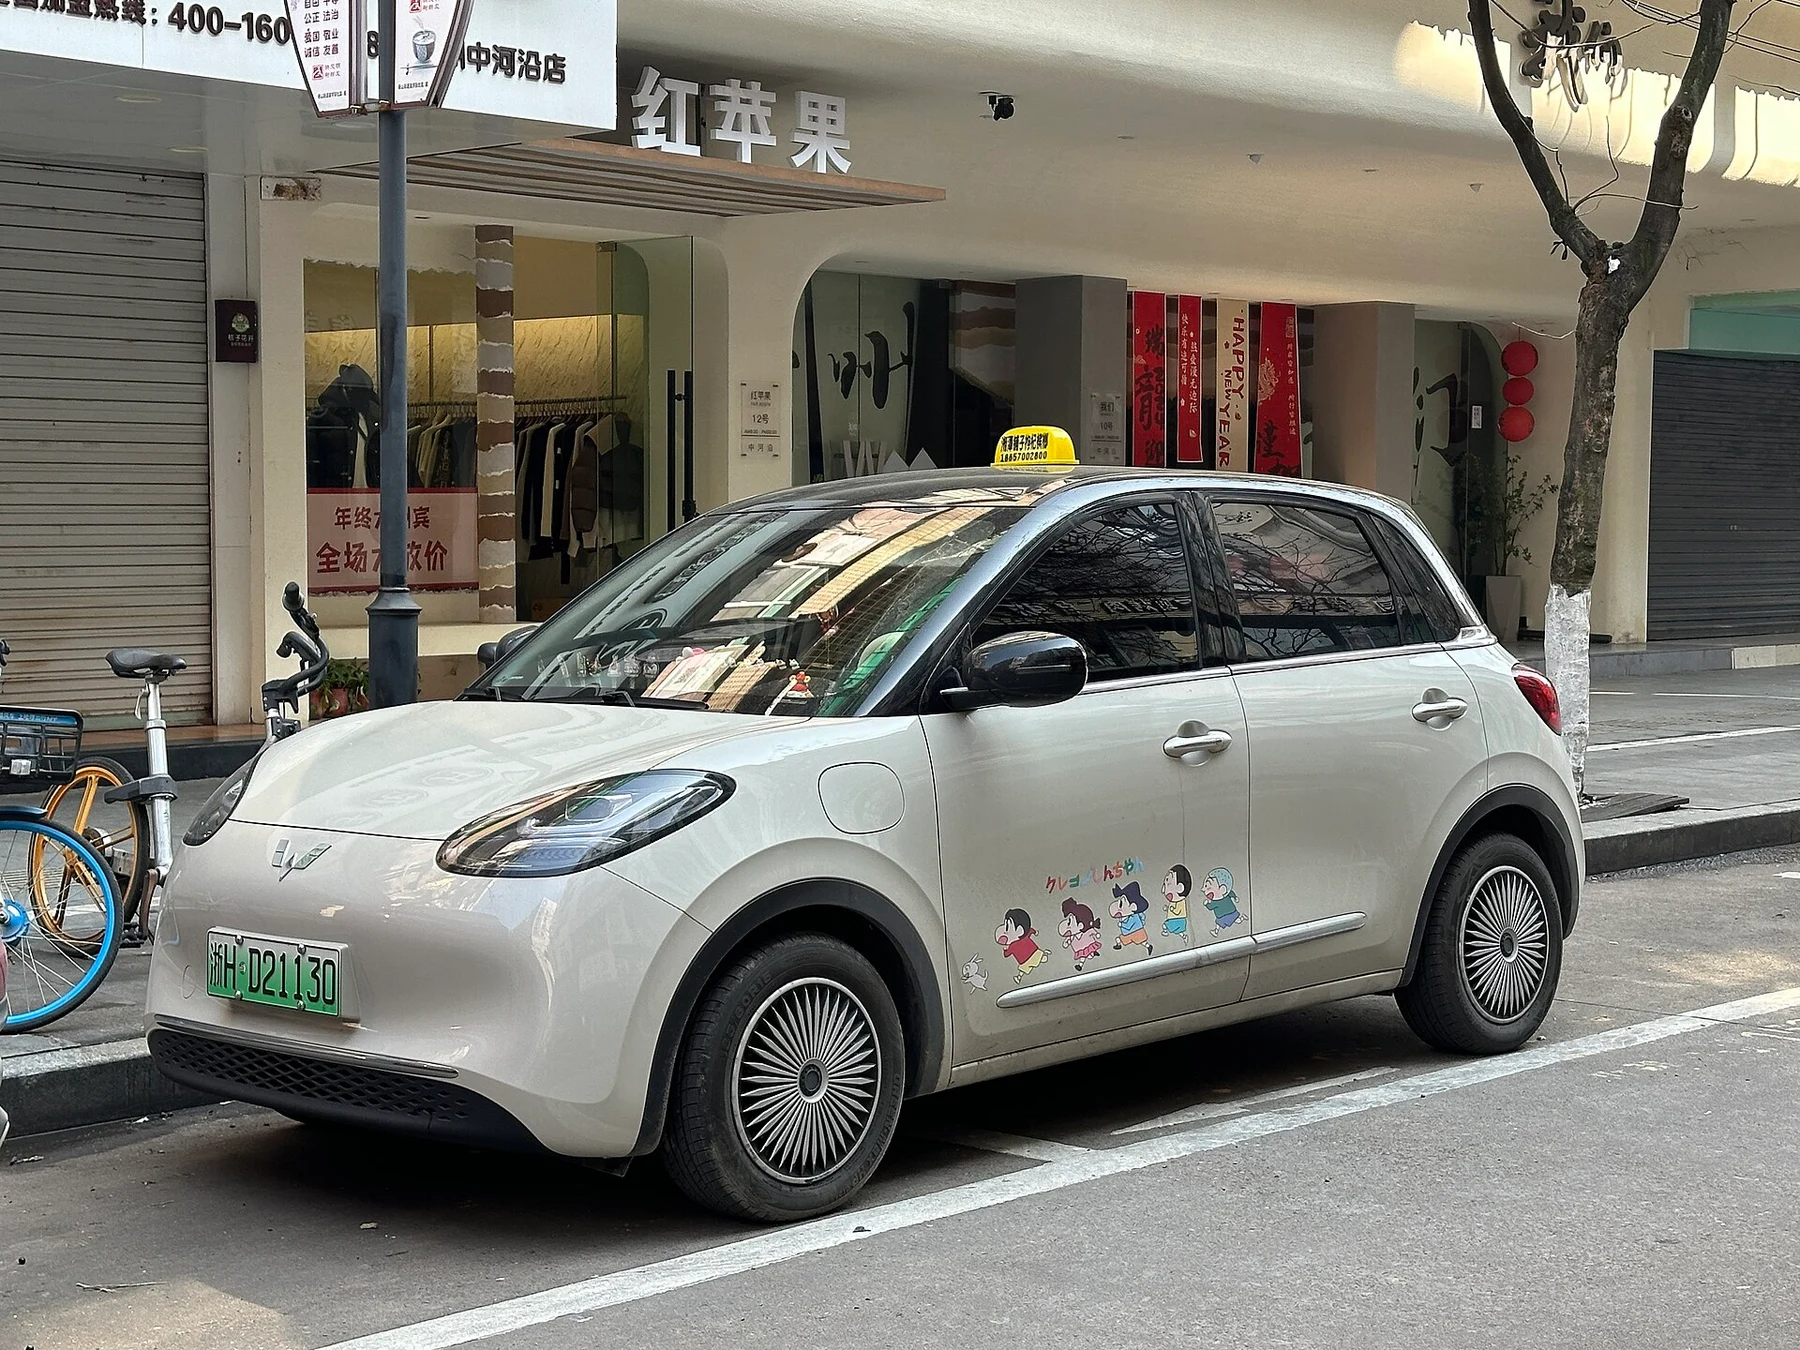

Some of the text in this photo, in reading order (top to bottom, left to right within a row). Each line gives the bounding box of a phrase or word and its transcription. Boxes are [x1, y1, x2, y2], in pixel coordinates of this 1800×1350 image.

[459, 40, 567, 84] 中河沿店
[631, 65, 852, 174] 红苹果
[1231, 317, 1245, 400] HAPPY
[752, 413, 770, 424] 12号
[1218, 369, 1232, 468] NEW YEAR
[1000, 450, 1048, 462] 18657002800
[334, 505, 431, 530] 年终宾
